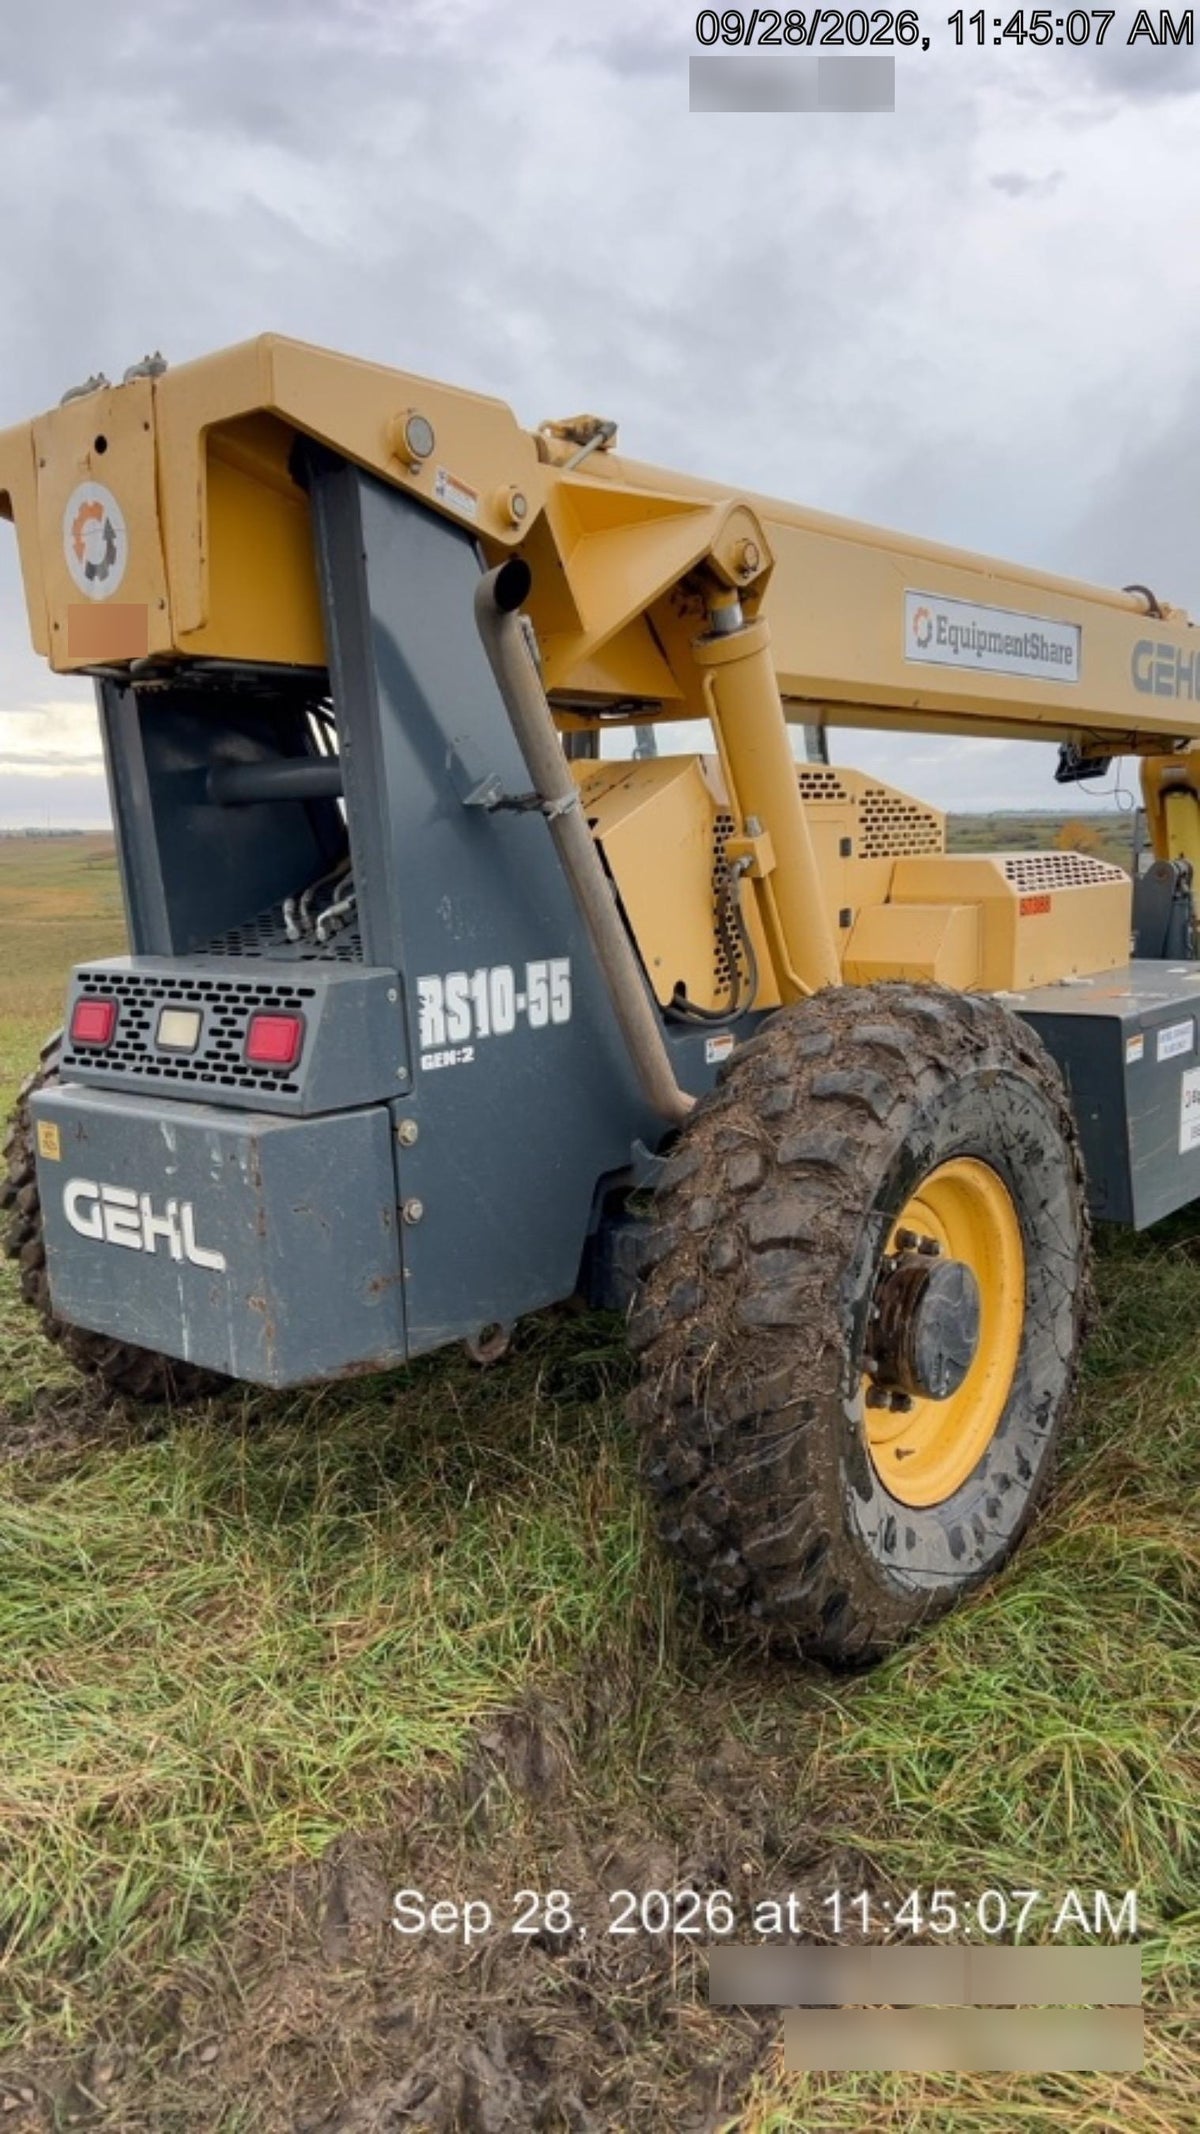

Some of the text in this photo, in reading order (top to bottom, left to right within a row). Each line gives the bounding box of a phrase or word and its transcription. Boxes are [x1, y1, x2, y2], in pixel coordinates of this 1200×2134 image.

[935, 614, 1073, 666] EquipmentShare
[416, 957, 572, 1050] RS10-55
[62, 1177, 227, 1275] GEHL
